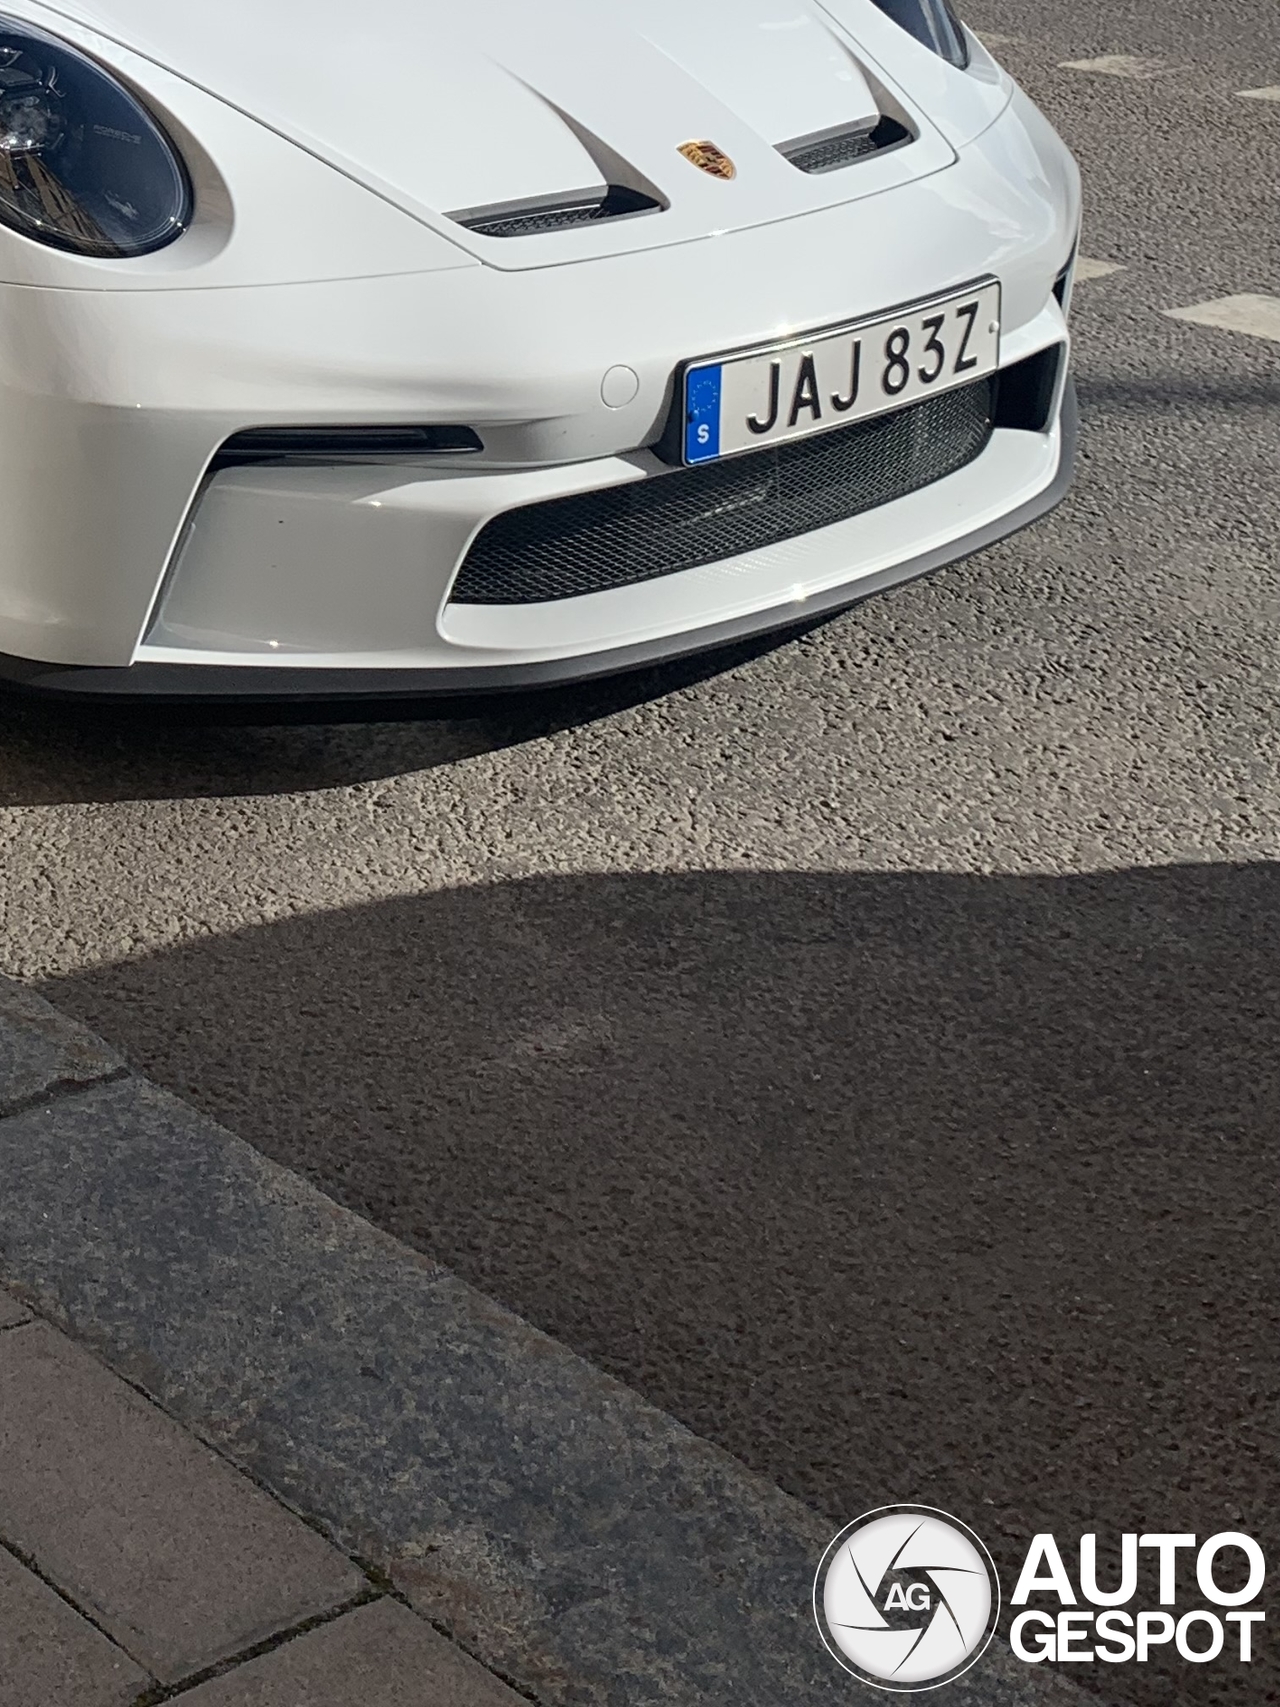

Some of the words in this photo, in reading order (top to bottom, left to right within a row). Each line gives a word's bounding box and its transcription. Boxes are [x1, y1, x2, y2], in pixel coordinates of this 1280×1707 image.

[746, 338, 863, 435] JAJ
[882, 300, 981, 397] 83Z
[697, 424, 710, 444] S
